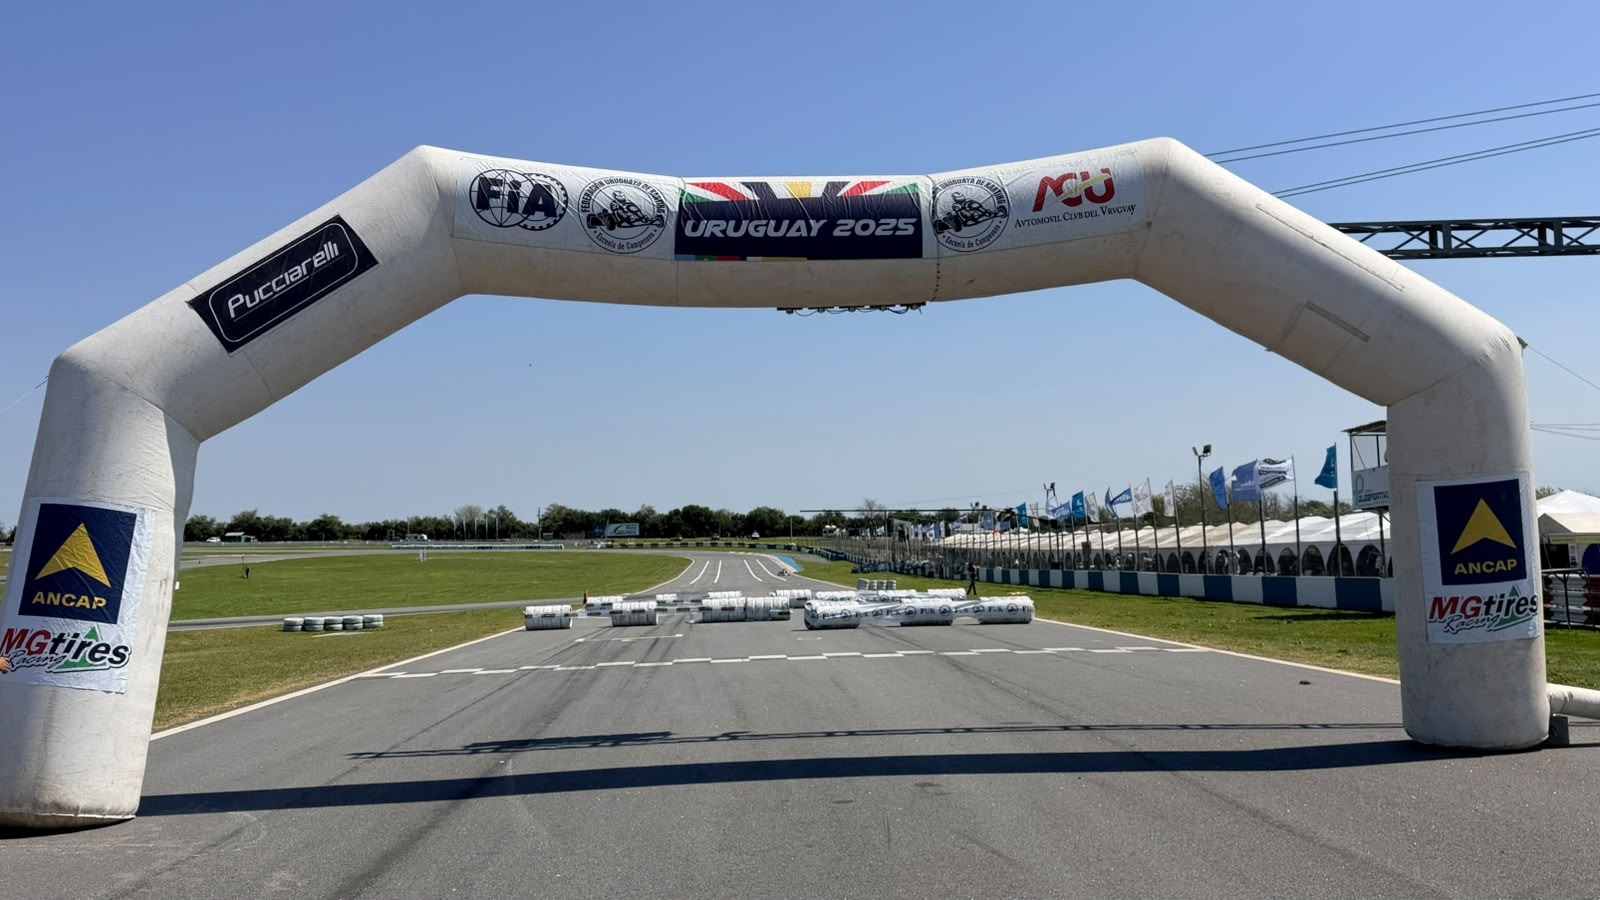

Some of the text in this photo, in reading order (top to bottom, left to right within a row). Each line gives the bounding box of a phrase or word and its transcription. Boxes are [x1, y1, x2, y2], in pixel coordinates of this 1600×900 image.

[684, 217, 918, 238] URUGUAY 2025
[227, 241, 339, 318] Pucciarelli
[1454, 559, 1518, 575] ANCAP
[32, 591, 107, 610] ANCAP
[1445, 614, 1501, 631] Racing
[9, 649, 67, 669] Racing
